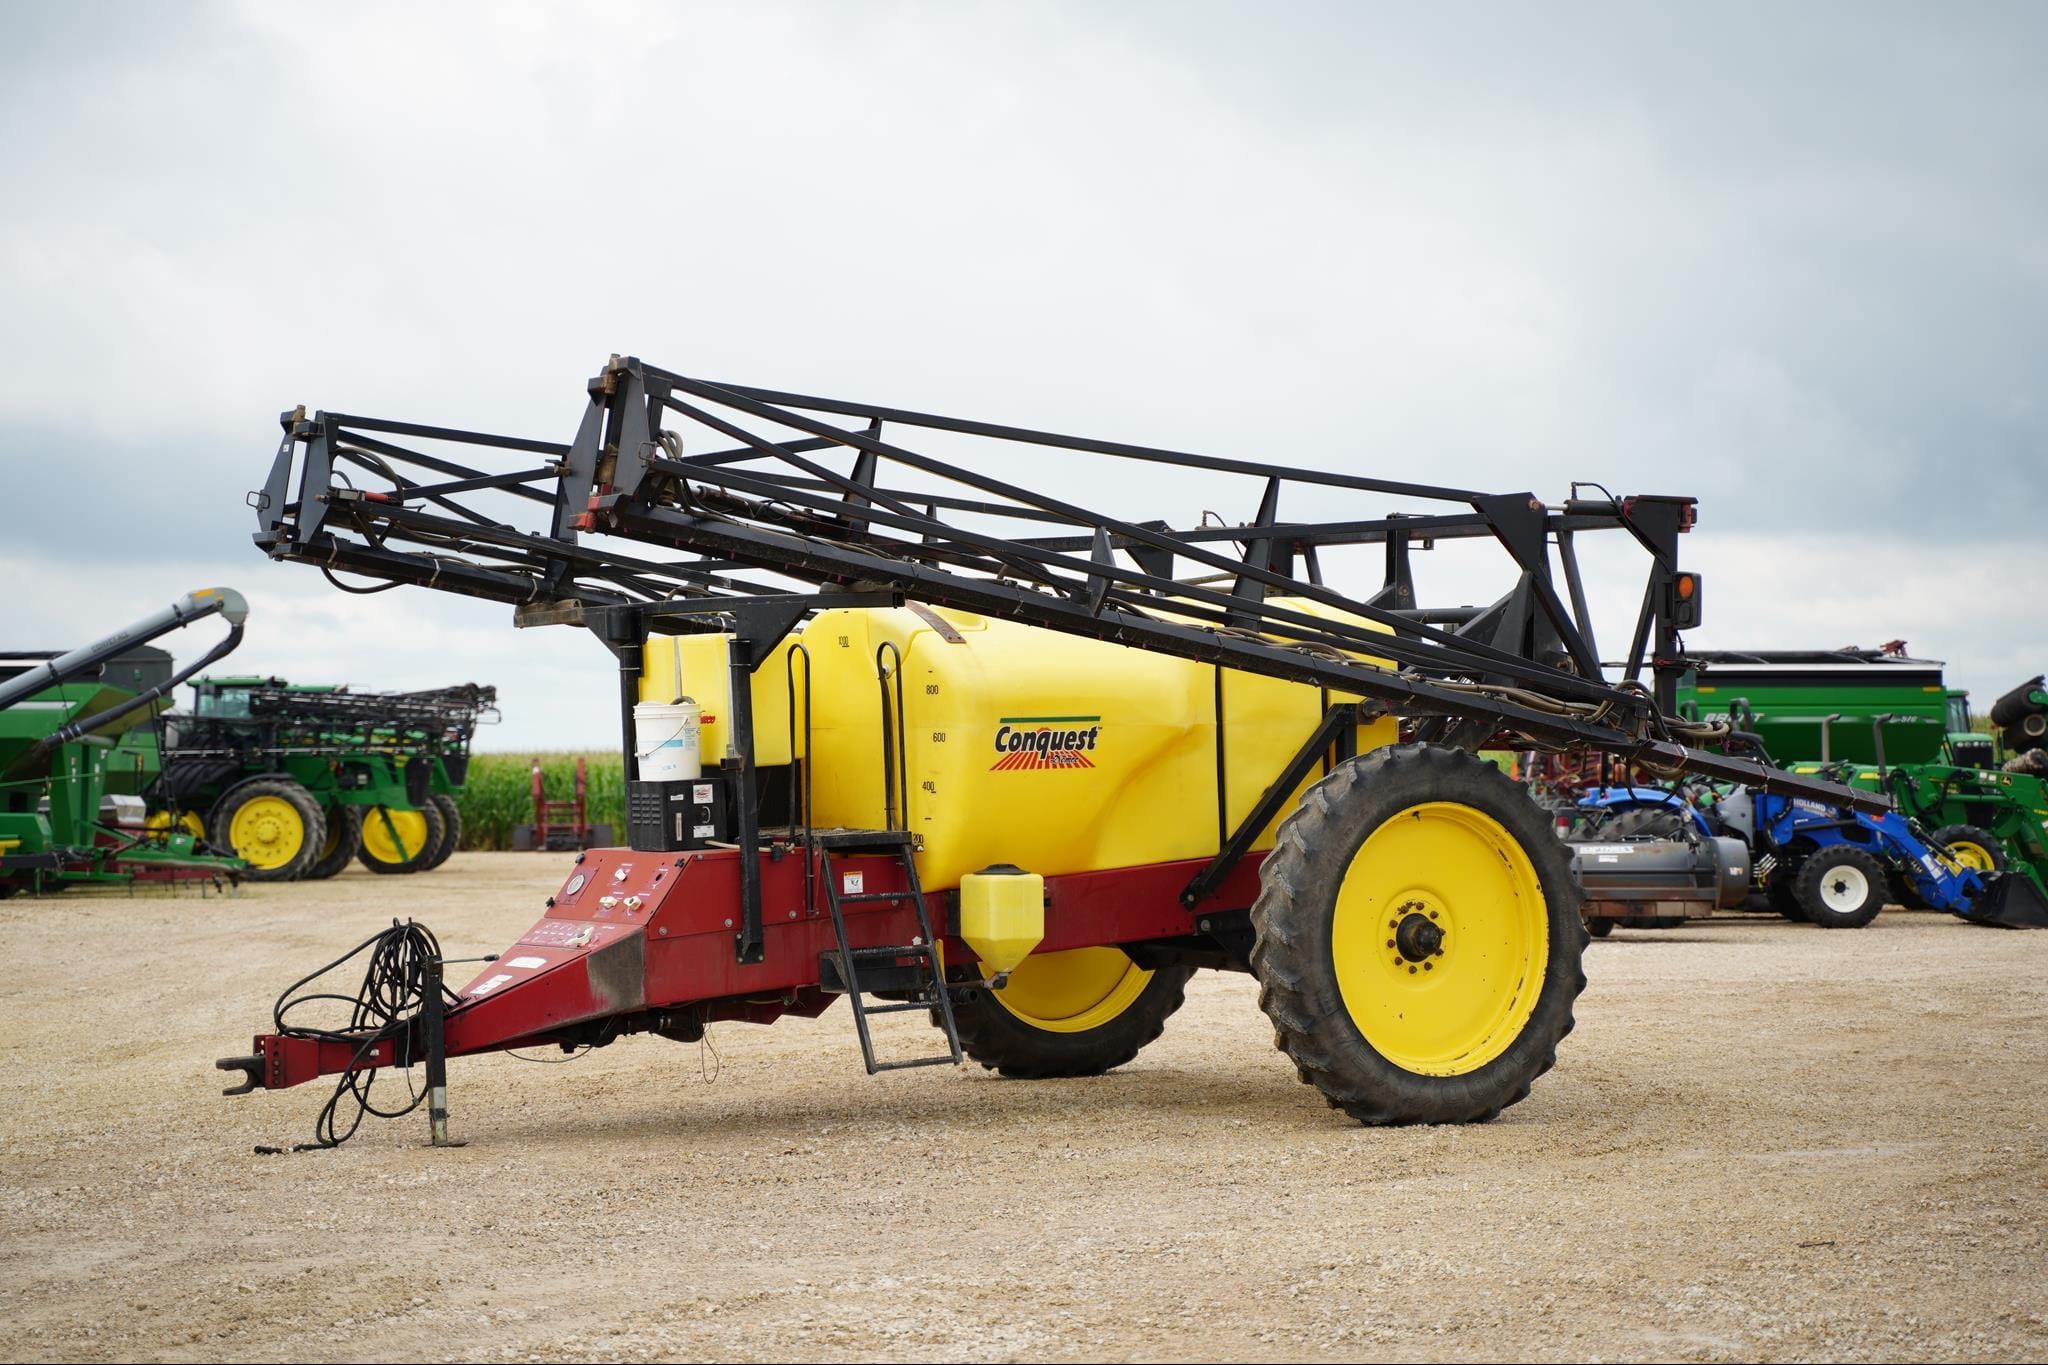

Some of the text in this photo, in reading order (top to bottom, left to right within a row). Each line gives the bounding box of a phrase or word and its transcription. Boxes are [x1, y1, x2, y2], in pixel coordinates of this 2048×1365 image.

[926, 685, 939, 695] 800
[932, 732, 946, 743] 600
[995, 726, 1098, 760] Conquest
[922, 781, 935, 791] 400
